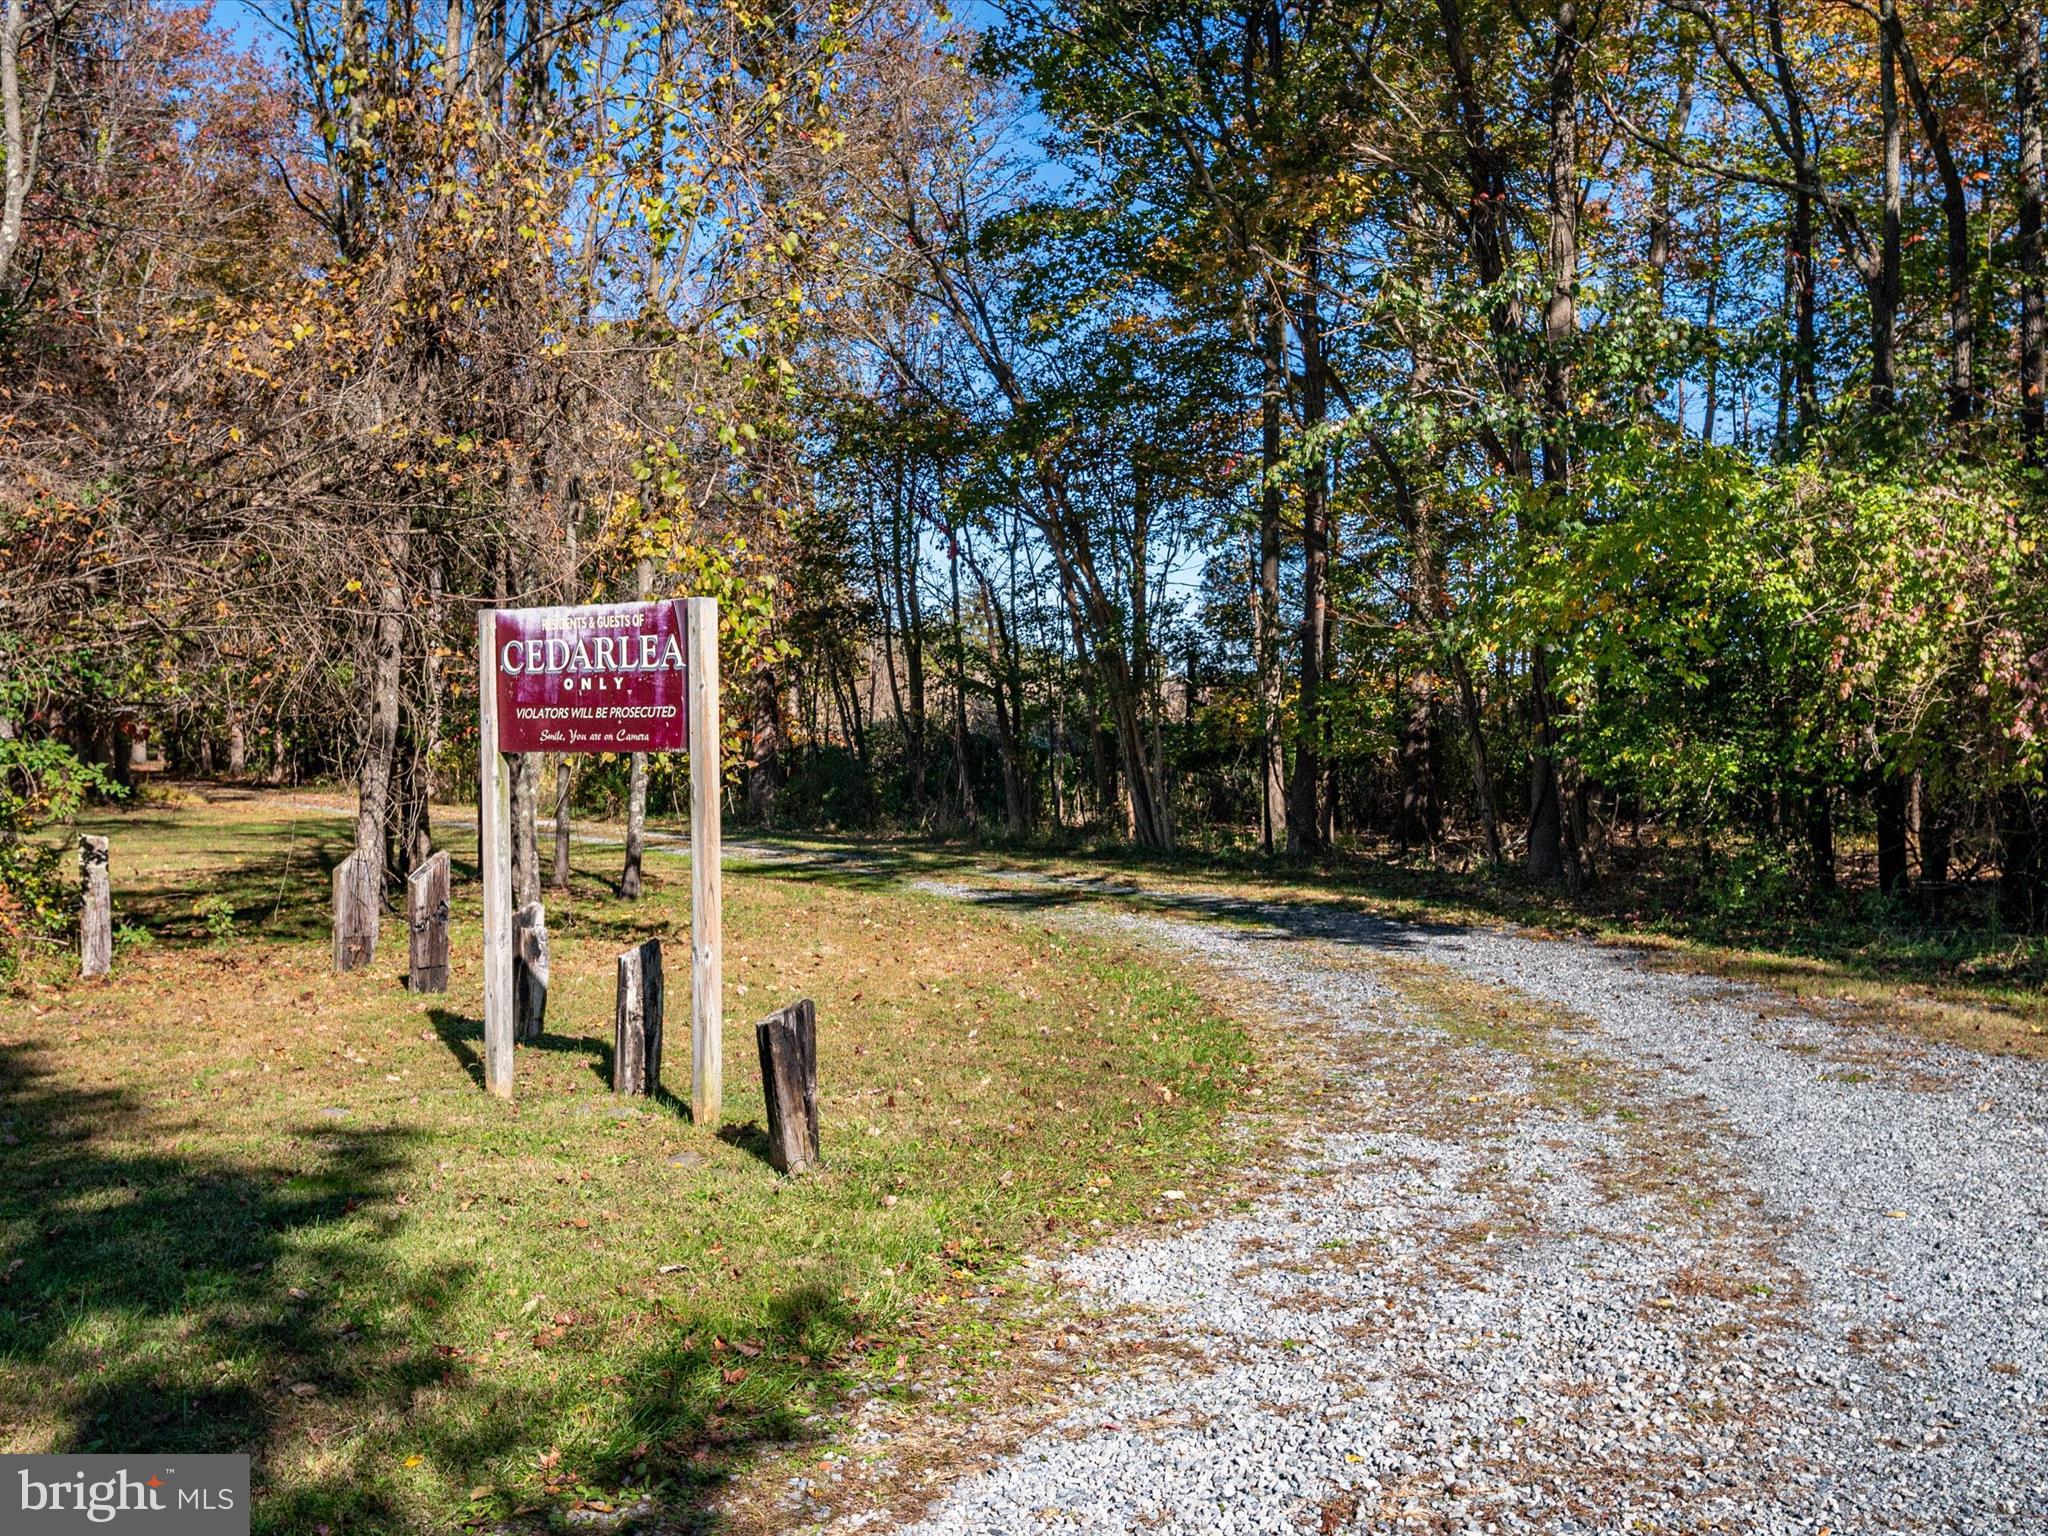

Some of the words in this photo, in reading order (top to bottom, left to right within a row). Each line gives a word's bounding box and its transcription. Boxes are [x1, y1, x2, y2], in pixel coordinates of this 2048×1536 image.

[542, 617, 587, 630] RESIDENTS
[588, 617, 595, 628] &
[597, 615, 630, 628] GUESTS
[631, 613, 644, 627] OF
[501, 633, 686, 674] CEDARLEA
[564, 677, 624, 691] ONLY
[517, 708, 569, 719] VIOLATORS
[571, 708, 593, 718] WILL
[596, 707, 608, 718] BE
[609, 706, 676, 718] PROSECUTED
[569, 729, 586, 743] You
[616, 729, 649, 741] Camera
